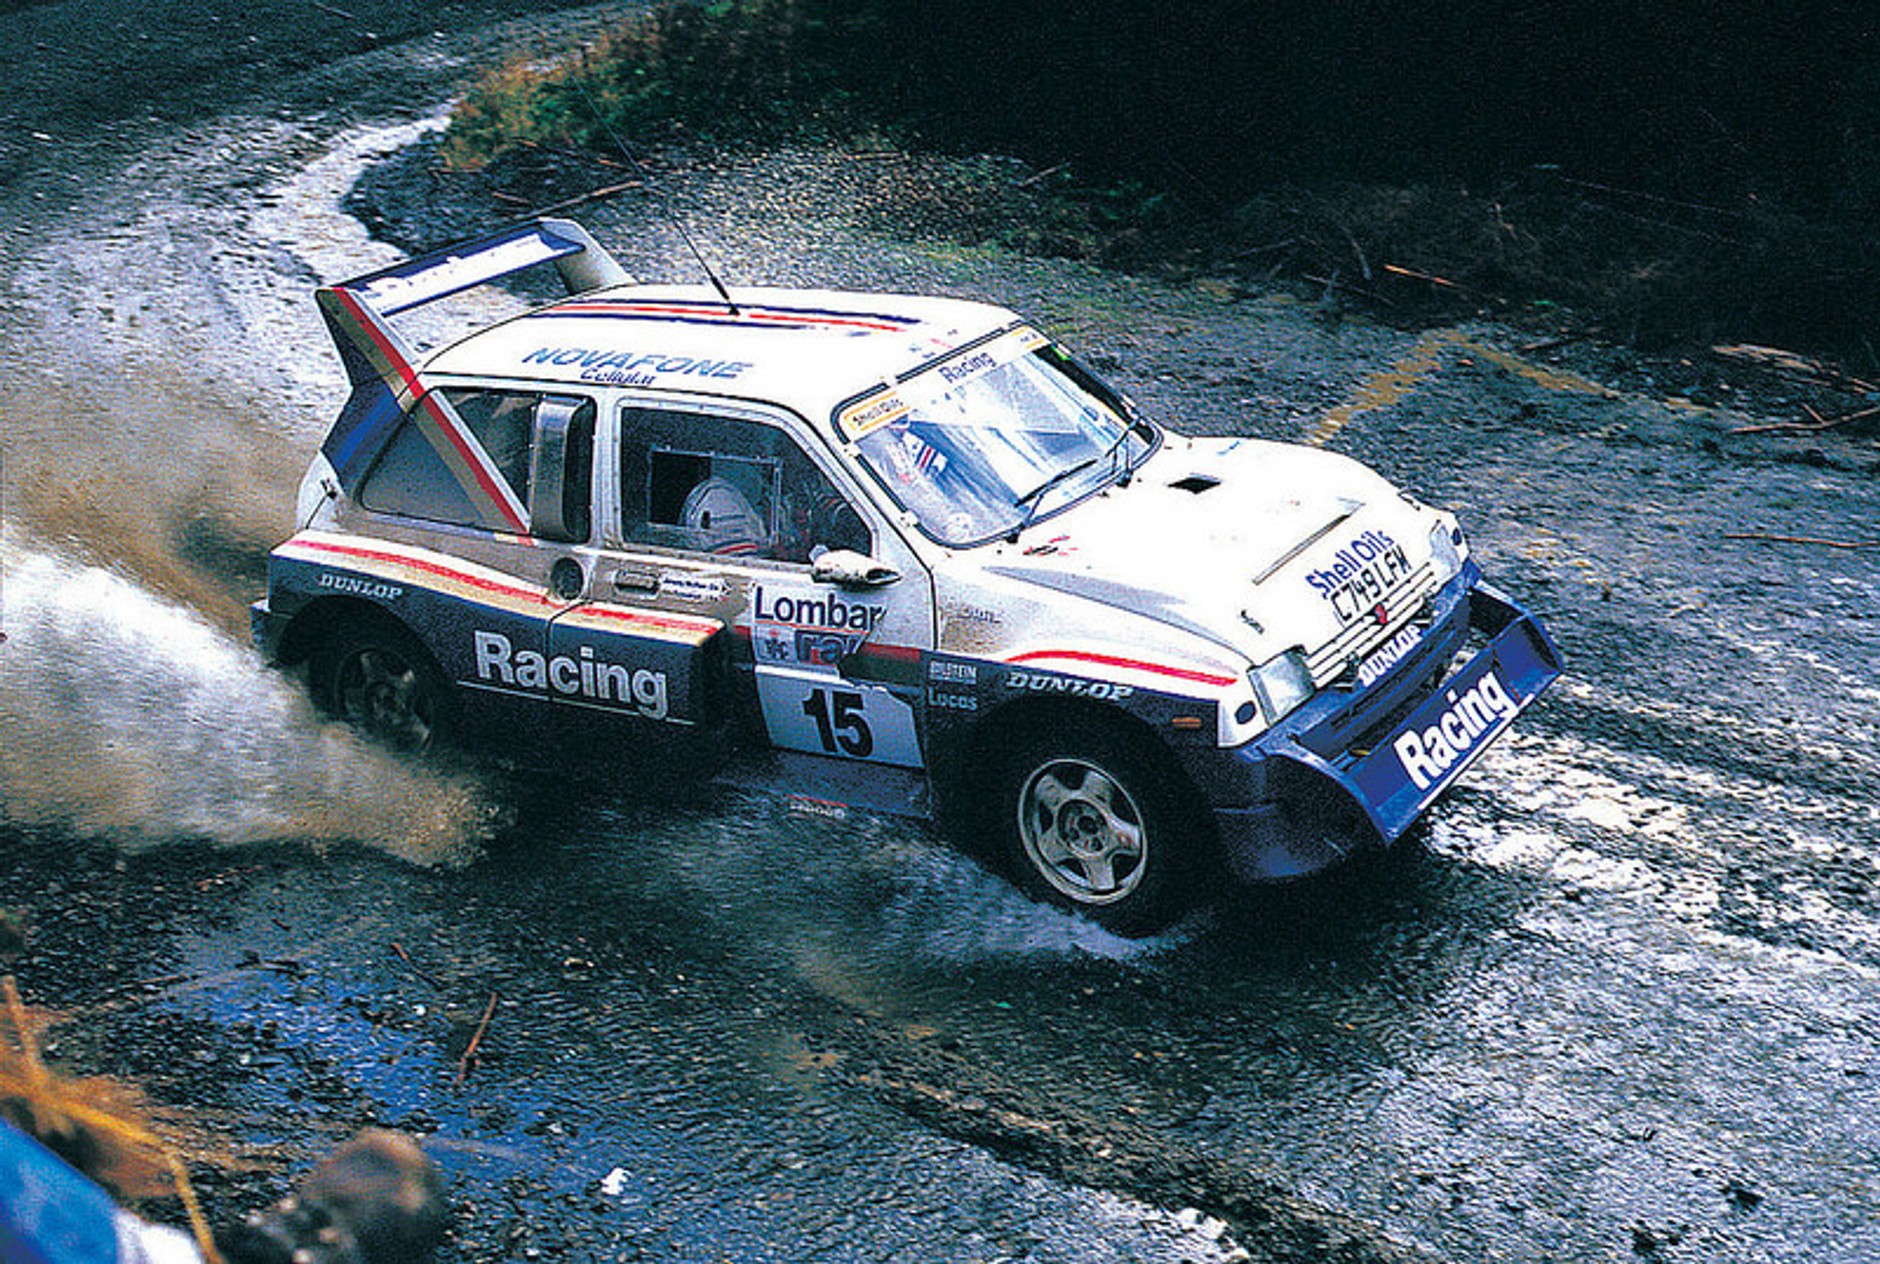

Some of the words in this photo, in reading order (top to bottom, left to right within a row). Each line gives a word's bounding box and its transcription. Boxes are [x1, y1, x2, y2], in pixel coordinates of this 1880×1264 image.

[522, 348, 753, 379] NOVAFONE
[938, 352, 997, 384] Racing
[319, 573, 403, 600] DUNLOP
[1305, 548, 1362, 600] Shell
[1351, 530, 1395, 562] Oils
[1331, 568, 1382, 621] C749
[474, 630, 669, 720] Racing
[1358, 624, 1423, 687] DUNLOP
[928, 686, 977, 711] Lucas
[1006, 671, 1135, 701] DUNLOP
[803, 688, 873, 757] 15
[1393, 671, 1519, 790] Racing
